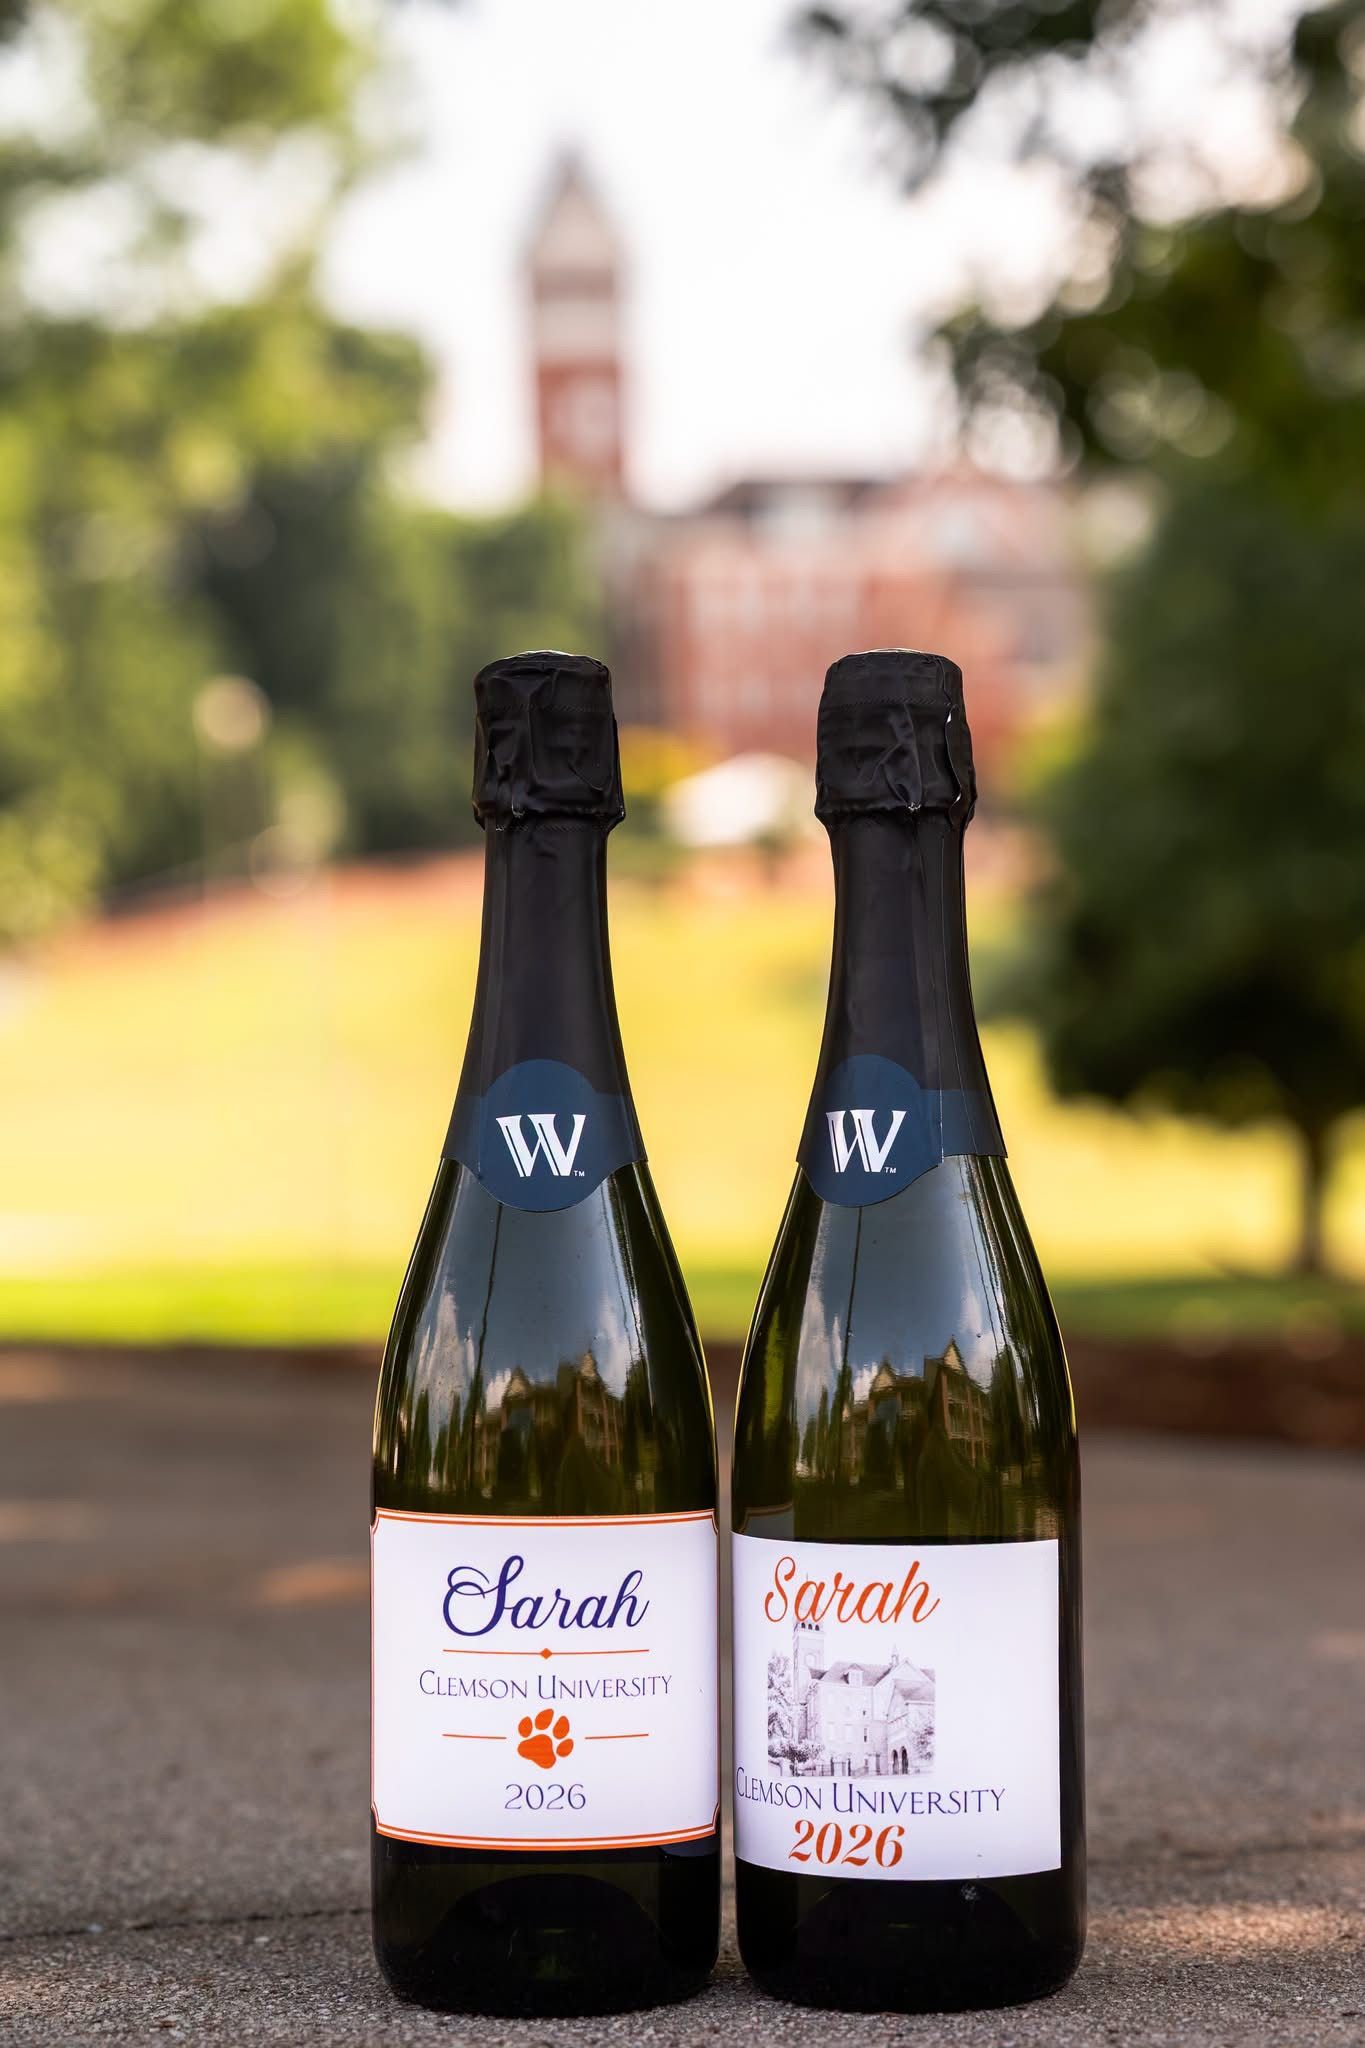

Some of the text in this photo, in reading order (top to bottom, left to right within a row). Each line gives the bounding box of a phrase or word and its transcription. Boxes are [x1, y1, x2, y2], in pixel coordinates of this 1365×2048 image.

[495, 1113, 586, 1177] W
[825, 1109, 907, 1173] W
[442, 1555, 650, 1637] Sarah
[764, 1556, 941, 1624] Sarah
[504, 1783, 587, 1810] 2026
[788, 1819, 905, 1868] 2026
